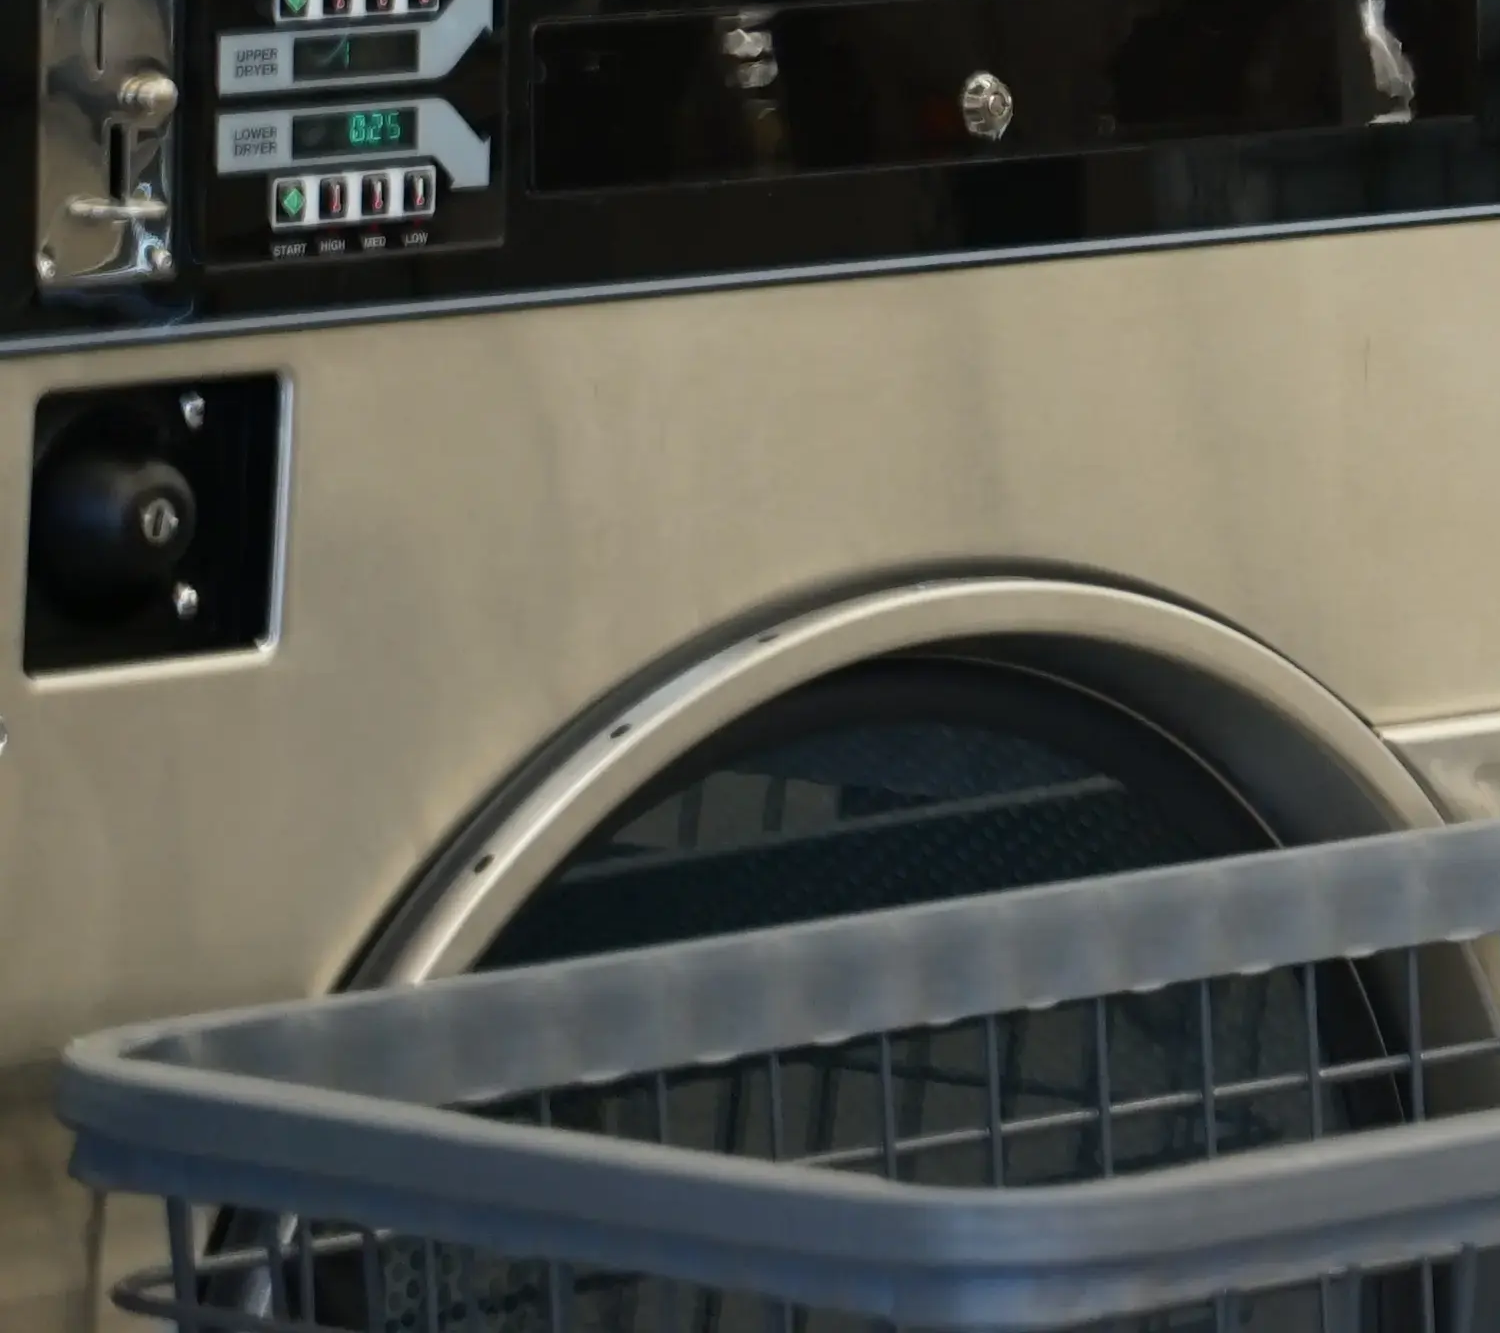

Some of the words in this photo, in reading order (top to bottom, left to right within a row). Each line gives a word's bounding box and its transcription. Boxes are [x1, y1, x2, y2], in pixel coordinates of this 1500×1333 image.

[237, 48, 278, 63] UPPER
[235, 64, 278, 78] DRYER
[234, 127, 277, 142] LOWER
[234, 142, 277, 156] DRYER
[273, 243, 307, 256] START
[320, 240, 346, 252] HIGH
[364, 236, 386, 247] MED
[405, 233, 428, 244] LOW
